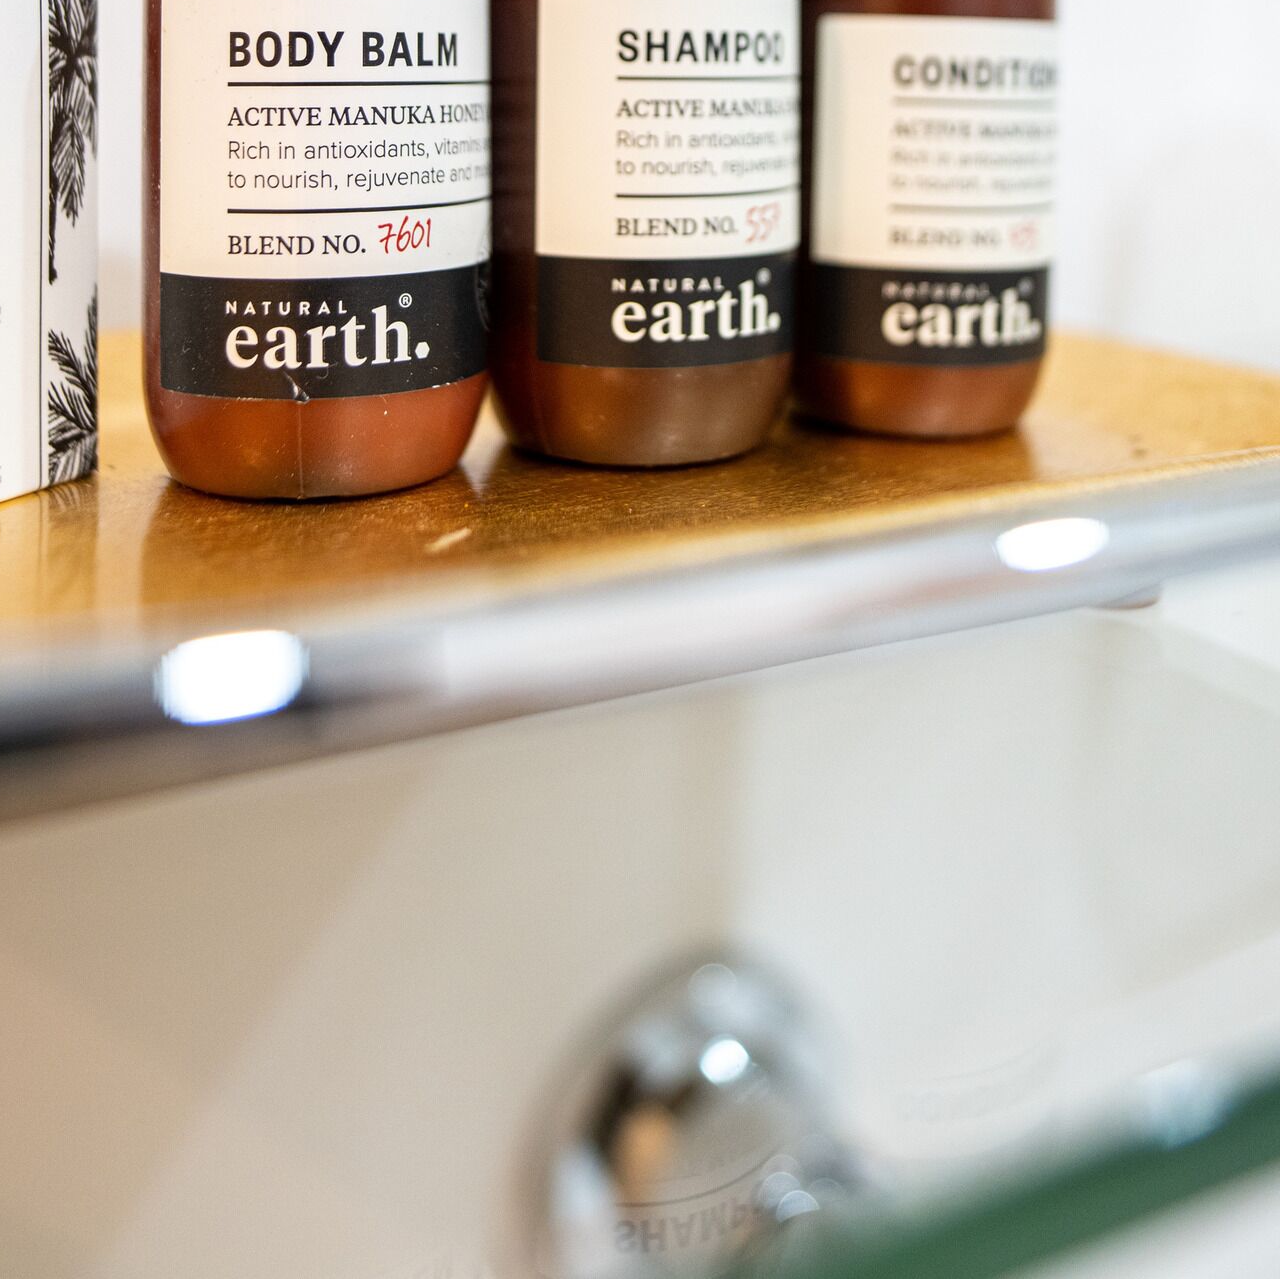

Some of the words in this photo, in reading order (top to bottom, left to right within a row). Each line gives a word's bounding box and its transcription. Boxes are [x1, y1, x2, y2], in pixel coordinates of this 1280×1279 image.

[229, 31, 345, 68] BODY
[362, 31, 459, 68] BALM
[227, 106, 322, 127] ACTIVE
[328, 105, 435, 126] MANUKA
[615, 98, 704, 119] ACTIVE
[227, 139, 271, 160] Rich
[278, 139, 296, 160] in
[304, 139, 430, 161] antioxidants,
[616, 130, 659, 149] Rich
[665, 130, 682, 148] in
[616, 158, 635, 175] to
[227, 170, 246, 189] to
[254, 168, 338, 191] nourish,
[346, 167, 446, 193] rejuvenate
[449, 164, 472, 183] and
[378, 216, 432, 254] 7601
[616, 216, 697, 237] BLEND
[702, 215, 738, 236] NO.
[227, 234, 315, 256] BLEND
[322, 234, 367, 255] NO.
[612, 277, 725, 294] NATURAL
[225, 299, 348, 316] NATURAL
